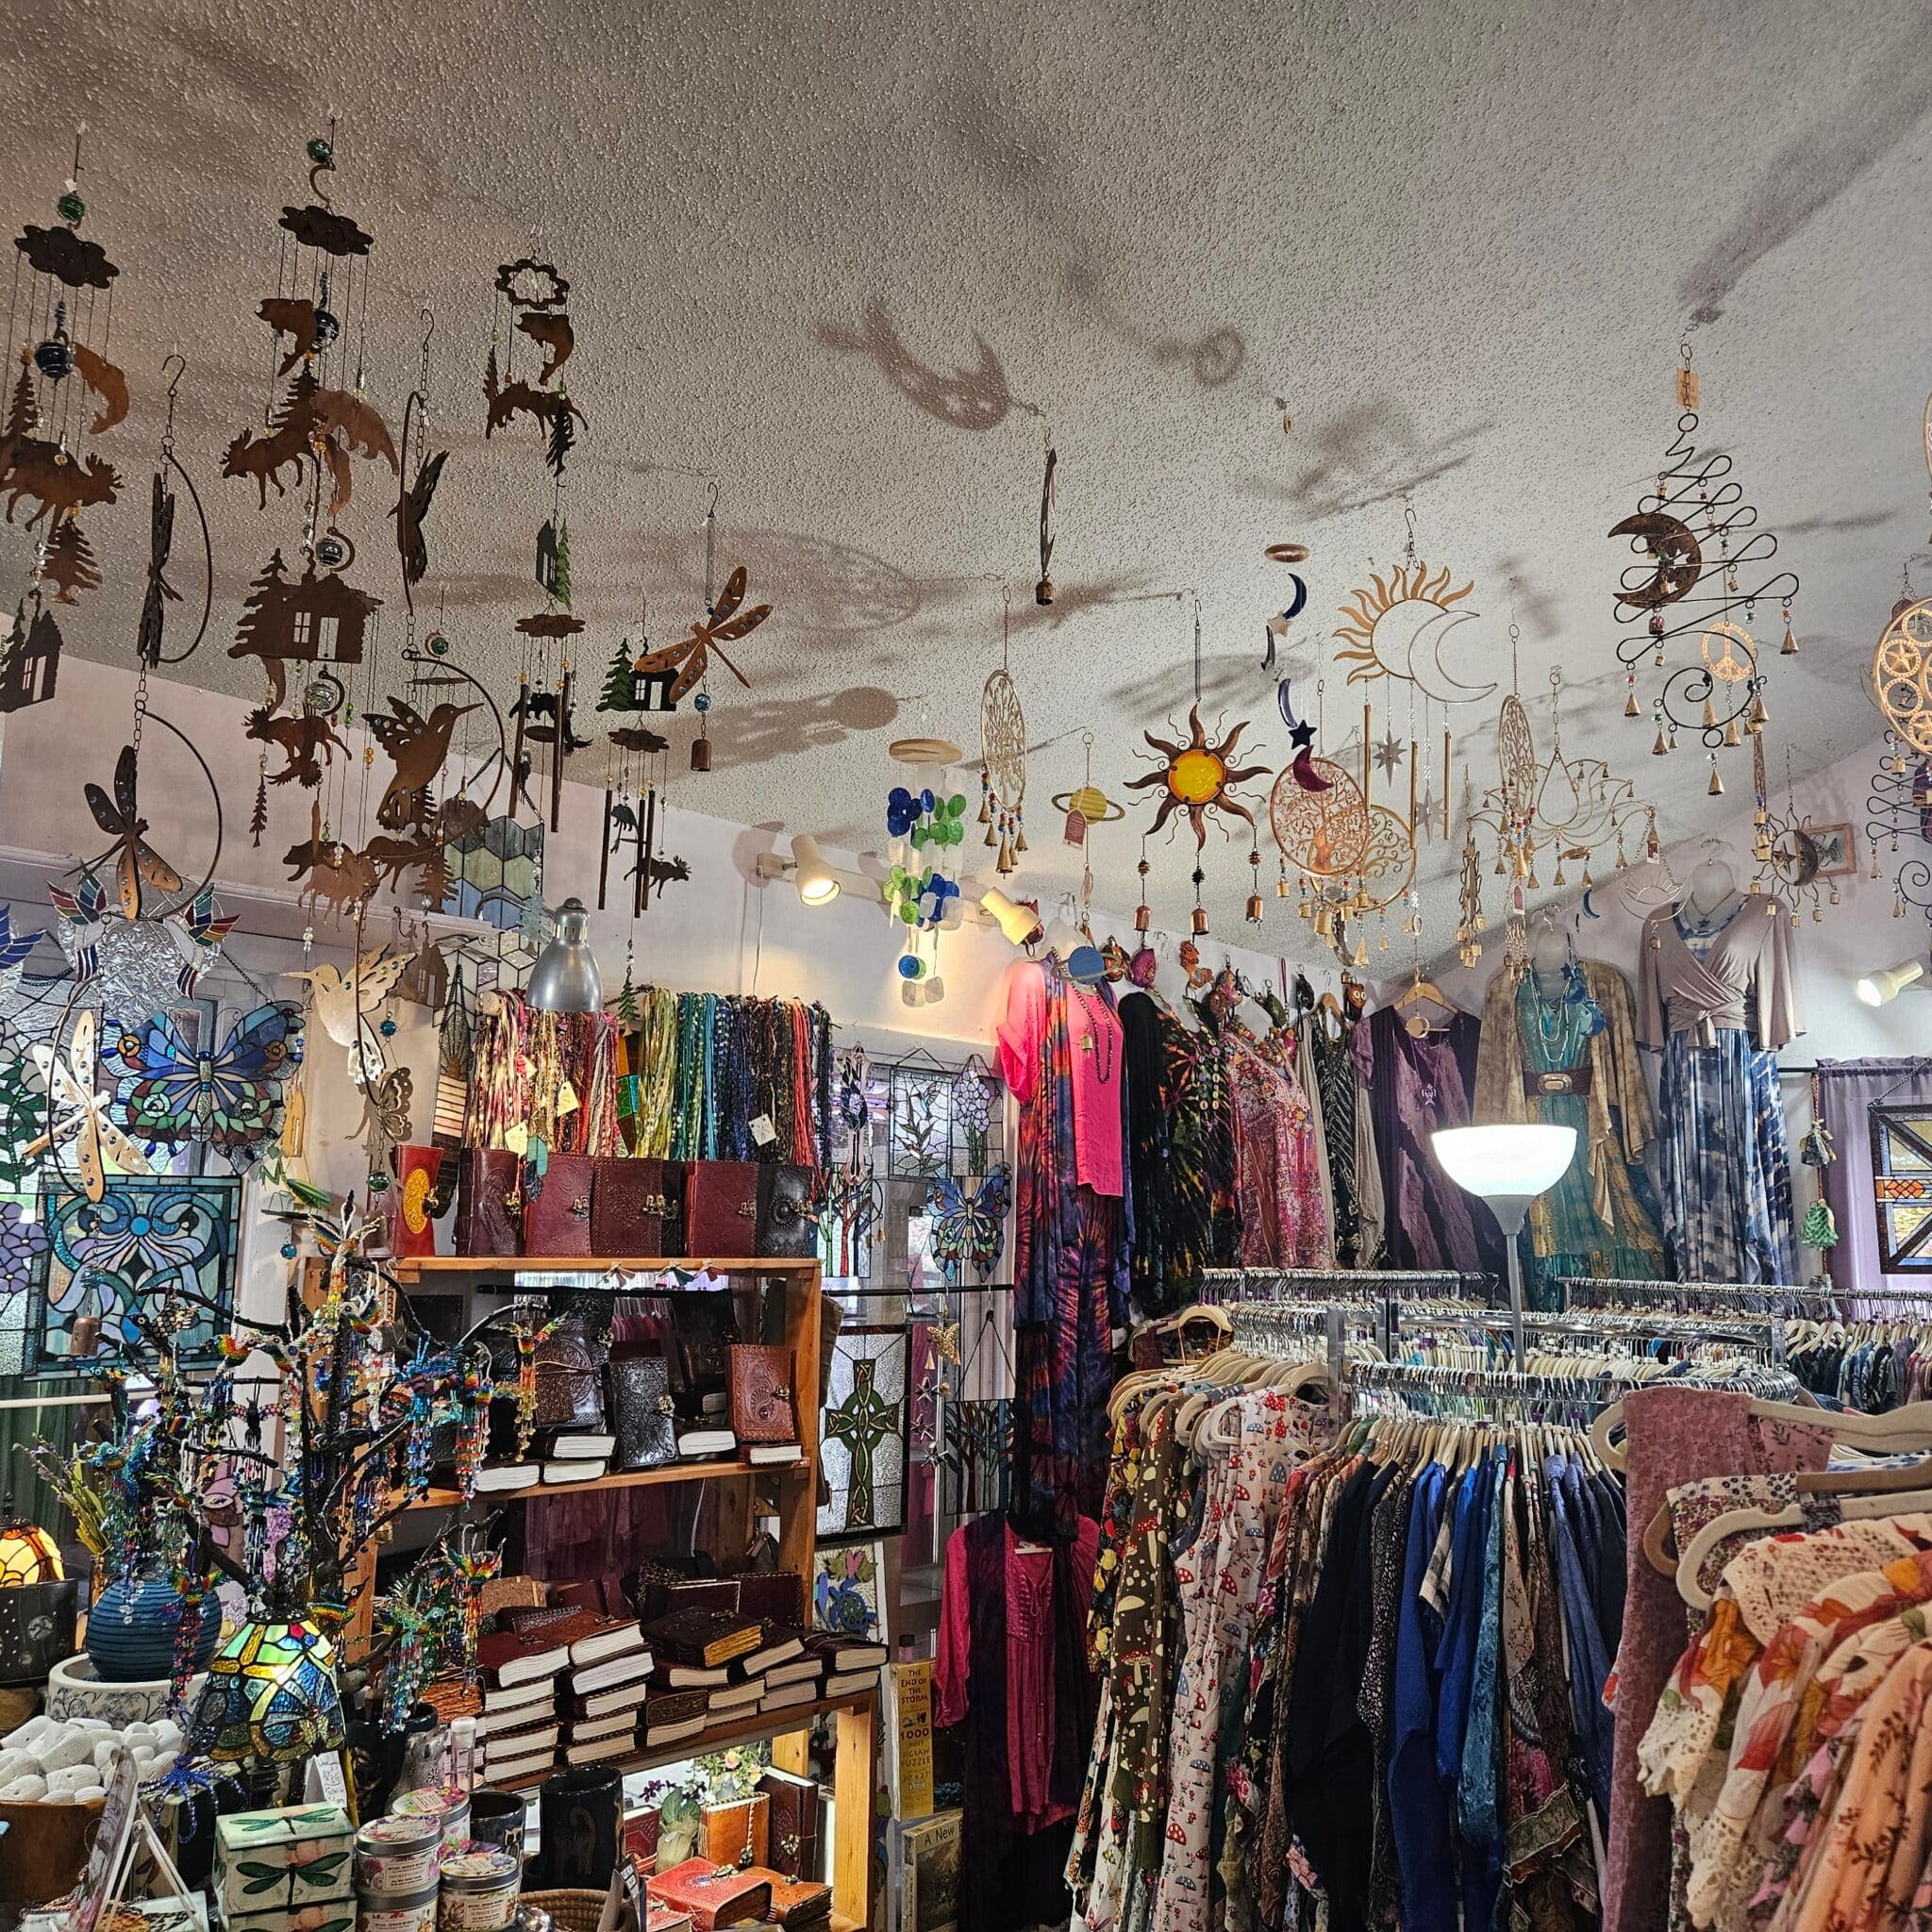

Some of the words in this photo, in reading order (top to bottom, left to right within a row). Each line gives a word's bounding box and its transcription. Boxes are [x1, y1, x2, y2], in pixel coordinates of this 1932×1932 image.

[908, 1669, 922, 1677] THE
[901, 1679, 917, 1688] END
[901, 1694, 928, 1705] STORM
[900, 1728, 929, 1740] 1000
[901, 1756, 931, 1767] PUZZLE
[924, 1833, 932, 1847] A
[935, 1825, 955, 1841] New
